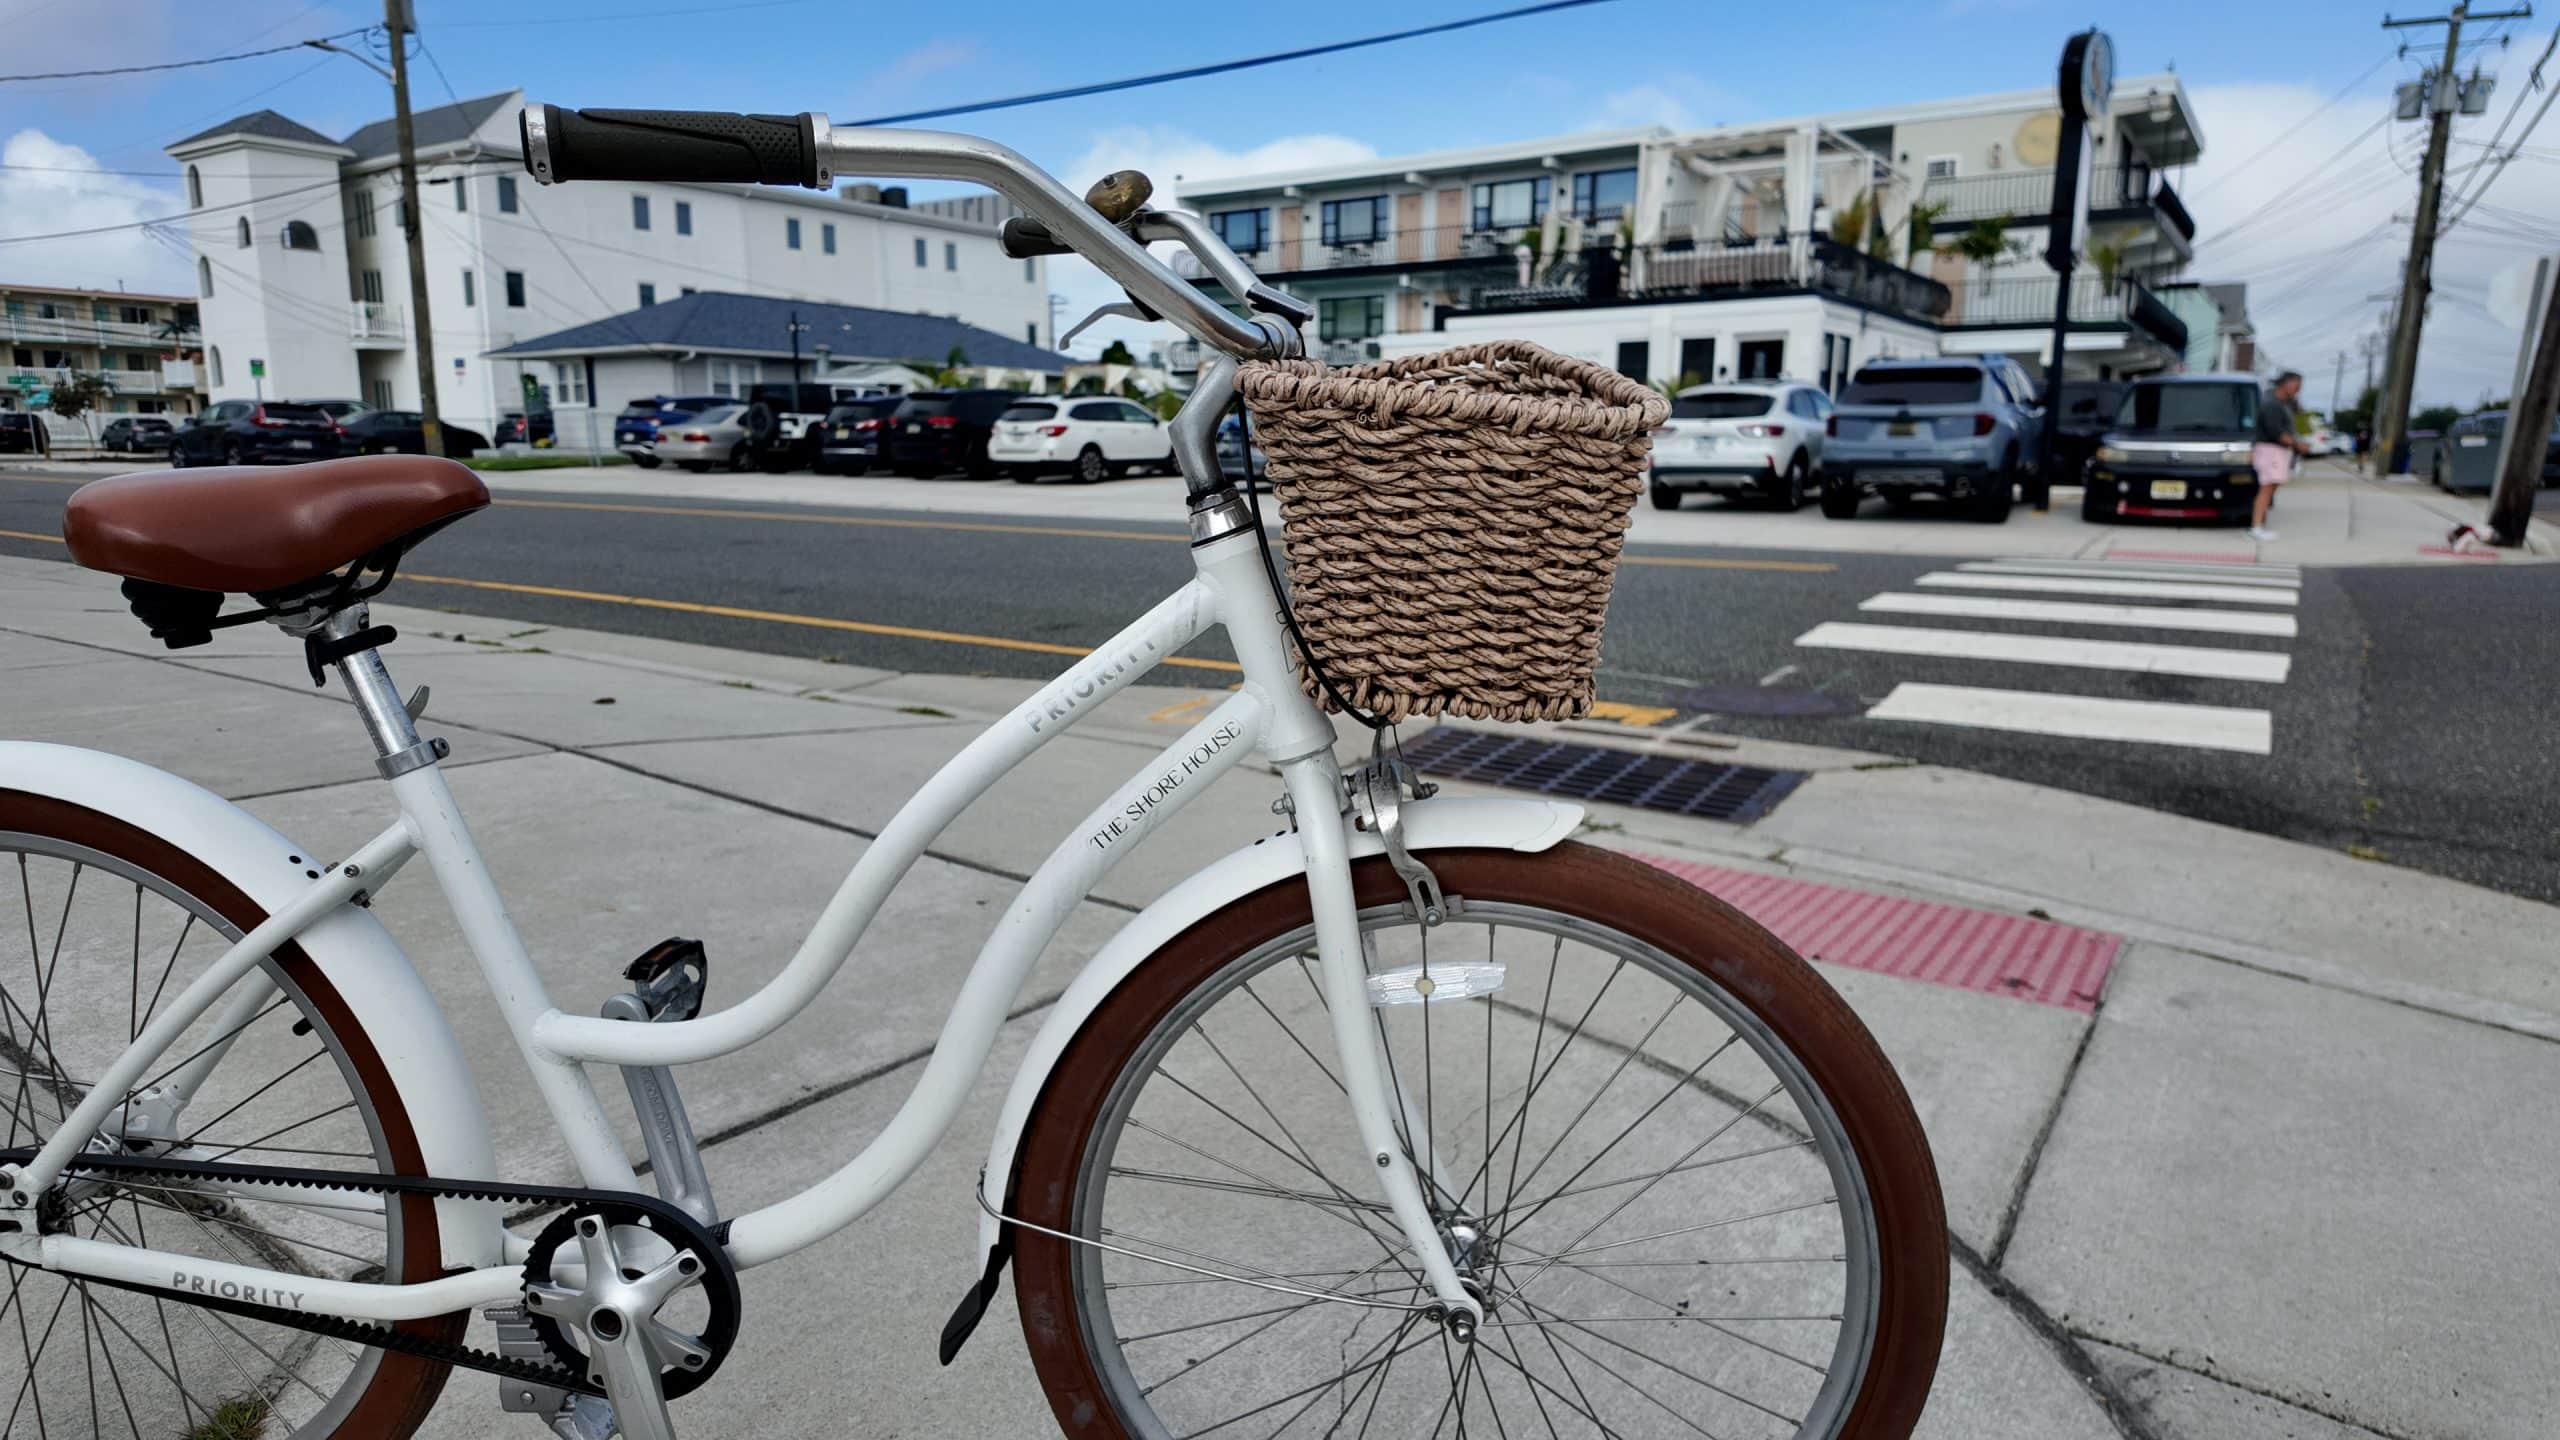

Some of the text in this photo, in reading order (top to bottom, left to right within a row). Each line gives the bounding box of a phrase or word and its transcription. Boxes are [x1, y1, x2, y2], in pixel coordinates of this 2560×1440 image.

[1089, 721, 1242, 850] THE SHORE HOUSE
[172, 1271, 305, 1309] PRIORITY
